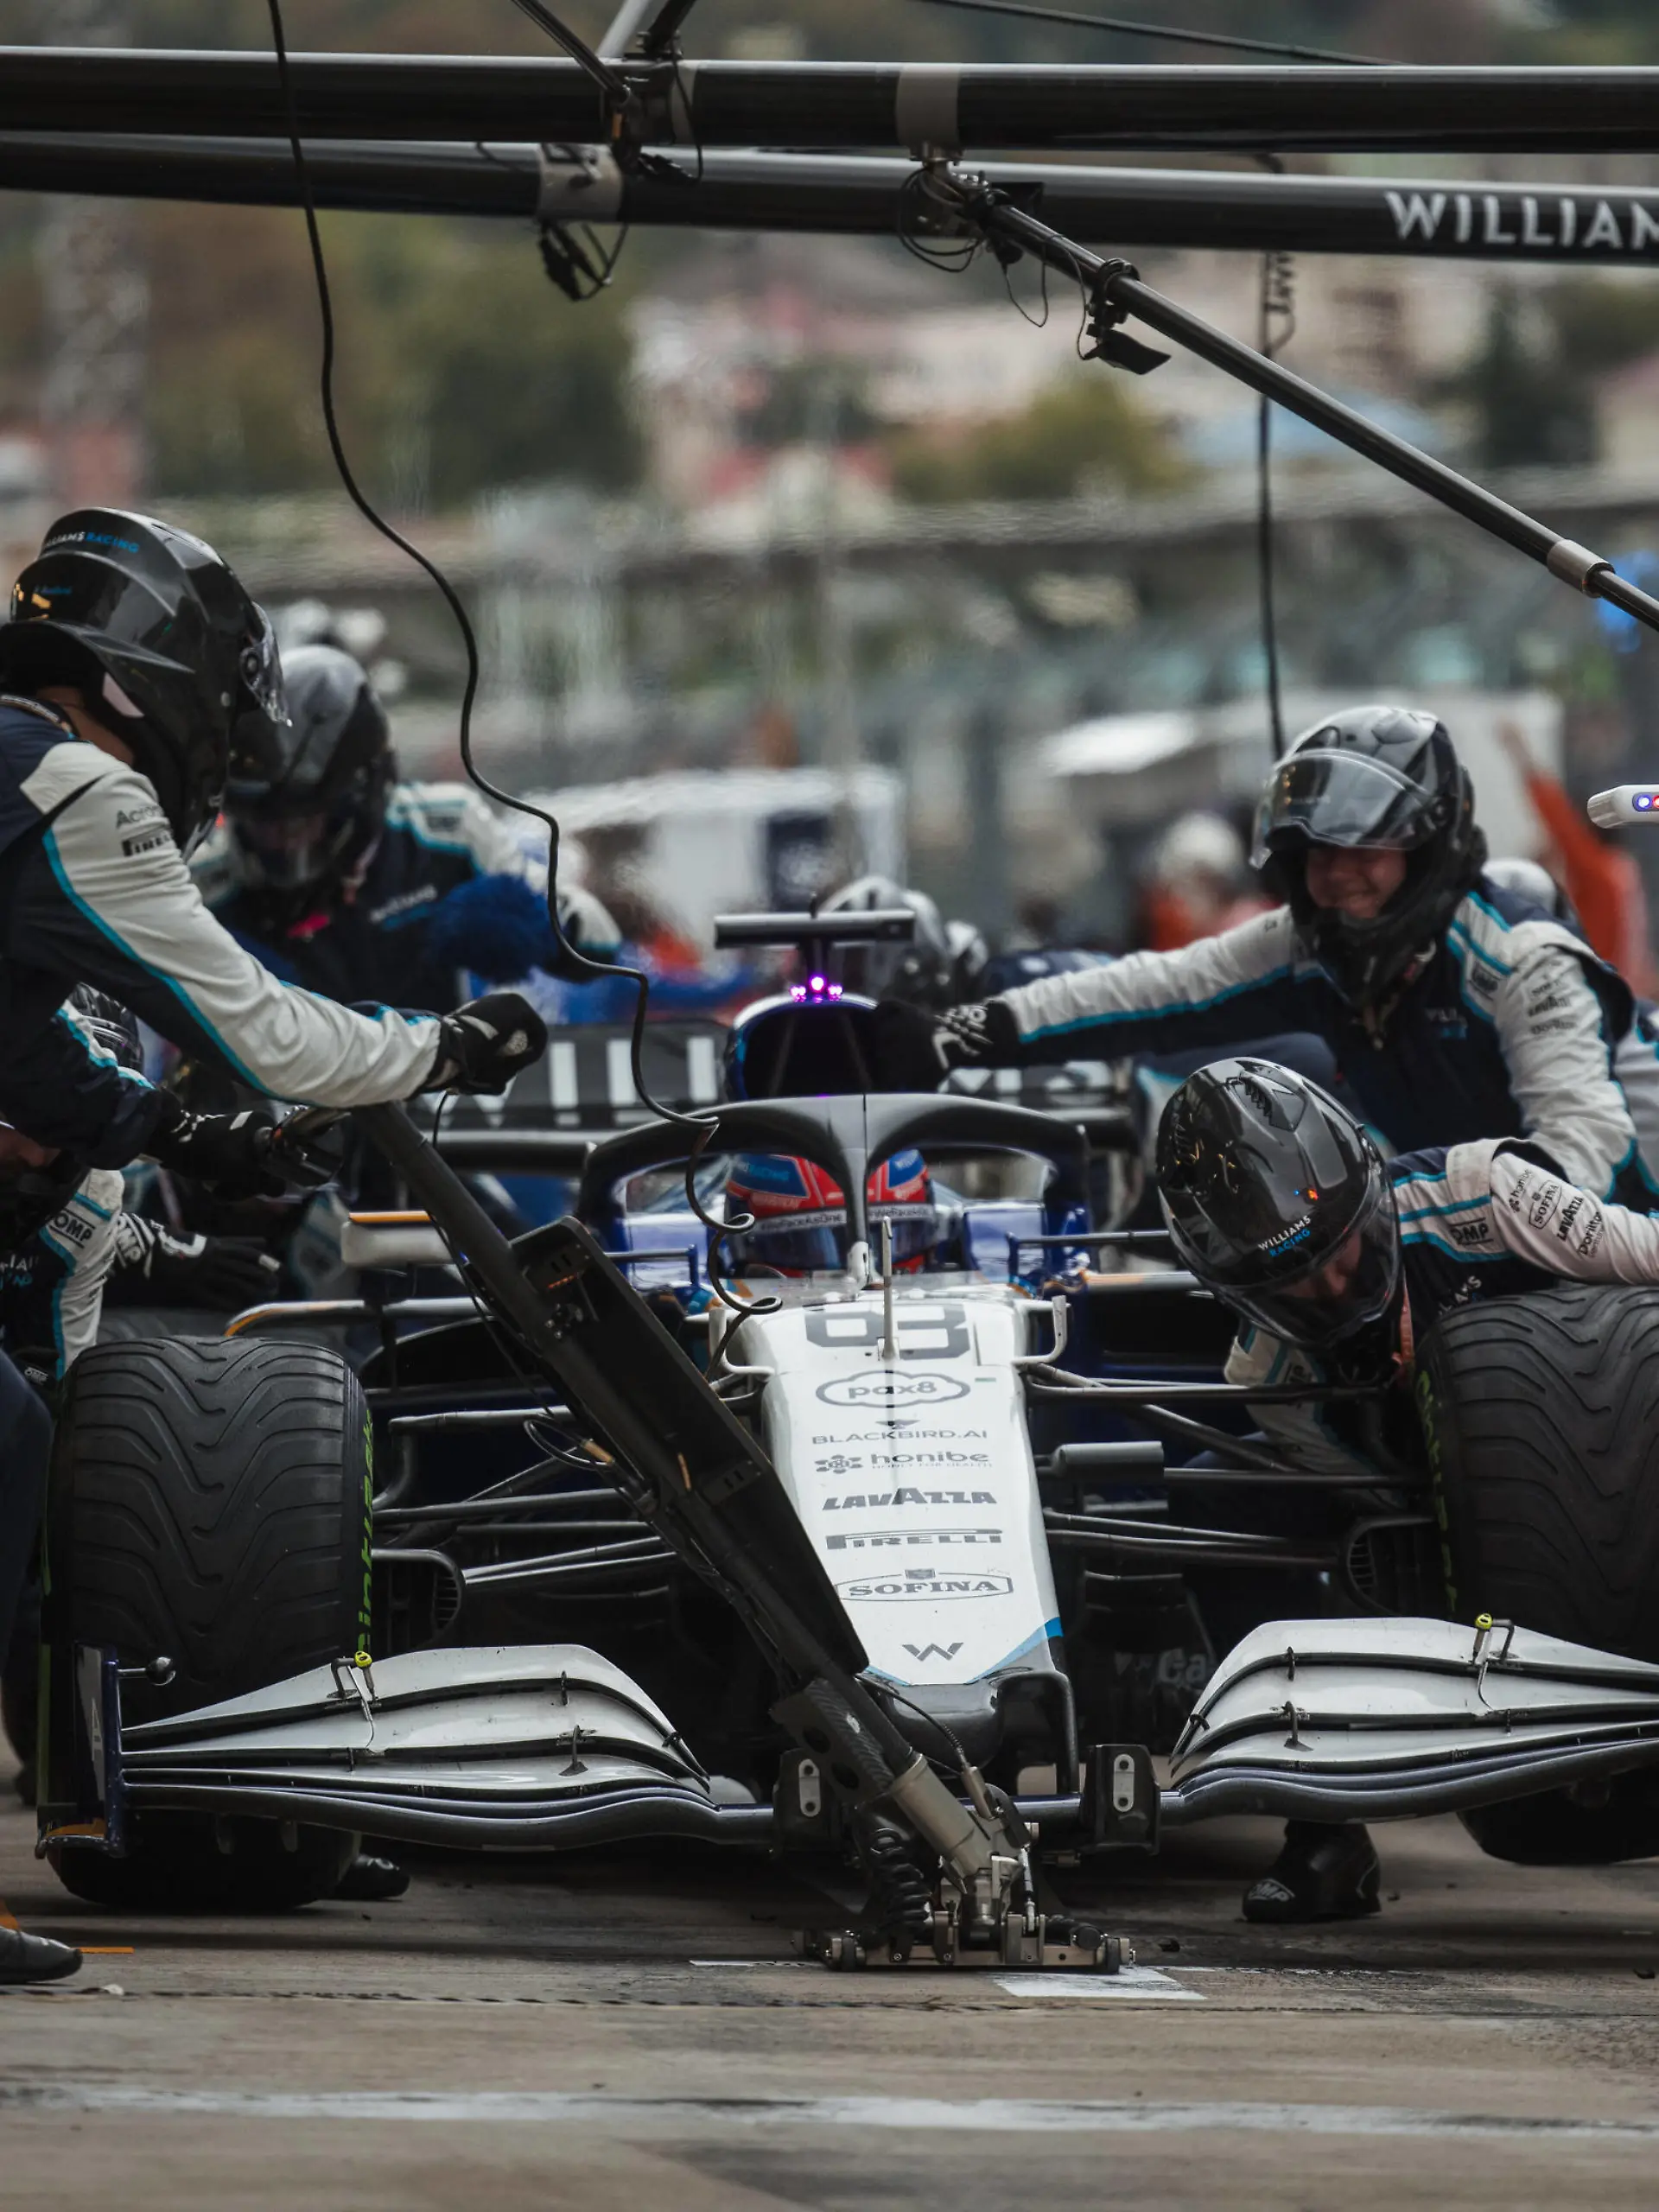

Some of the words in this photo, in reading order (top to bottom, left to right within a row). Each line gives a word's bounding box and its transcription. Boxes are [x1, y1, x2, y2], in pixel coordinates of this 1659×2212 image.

[54, 1211, 93, 1242] OMP
[1258, 1215, 1312, 1251] WILLIAMS
[1450, 1223, 1490, 1243] OMP
[1268, 1228, 1311, 1257] RACING
[848, 1382, 938, 1399] pax8
[812, 1429, 987, 1445] BLACKBIRD.AI
[870, 1451, 989, 1465] honibe
[823, 1488, 997, 1510] LAVAZZA
[826, 1529, 1002, 1549] PIRELLI
[849, 1580, 1001, 1597] SOFINA
